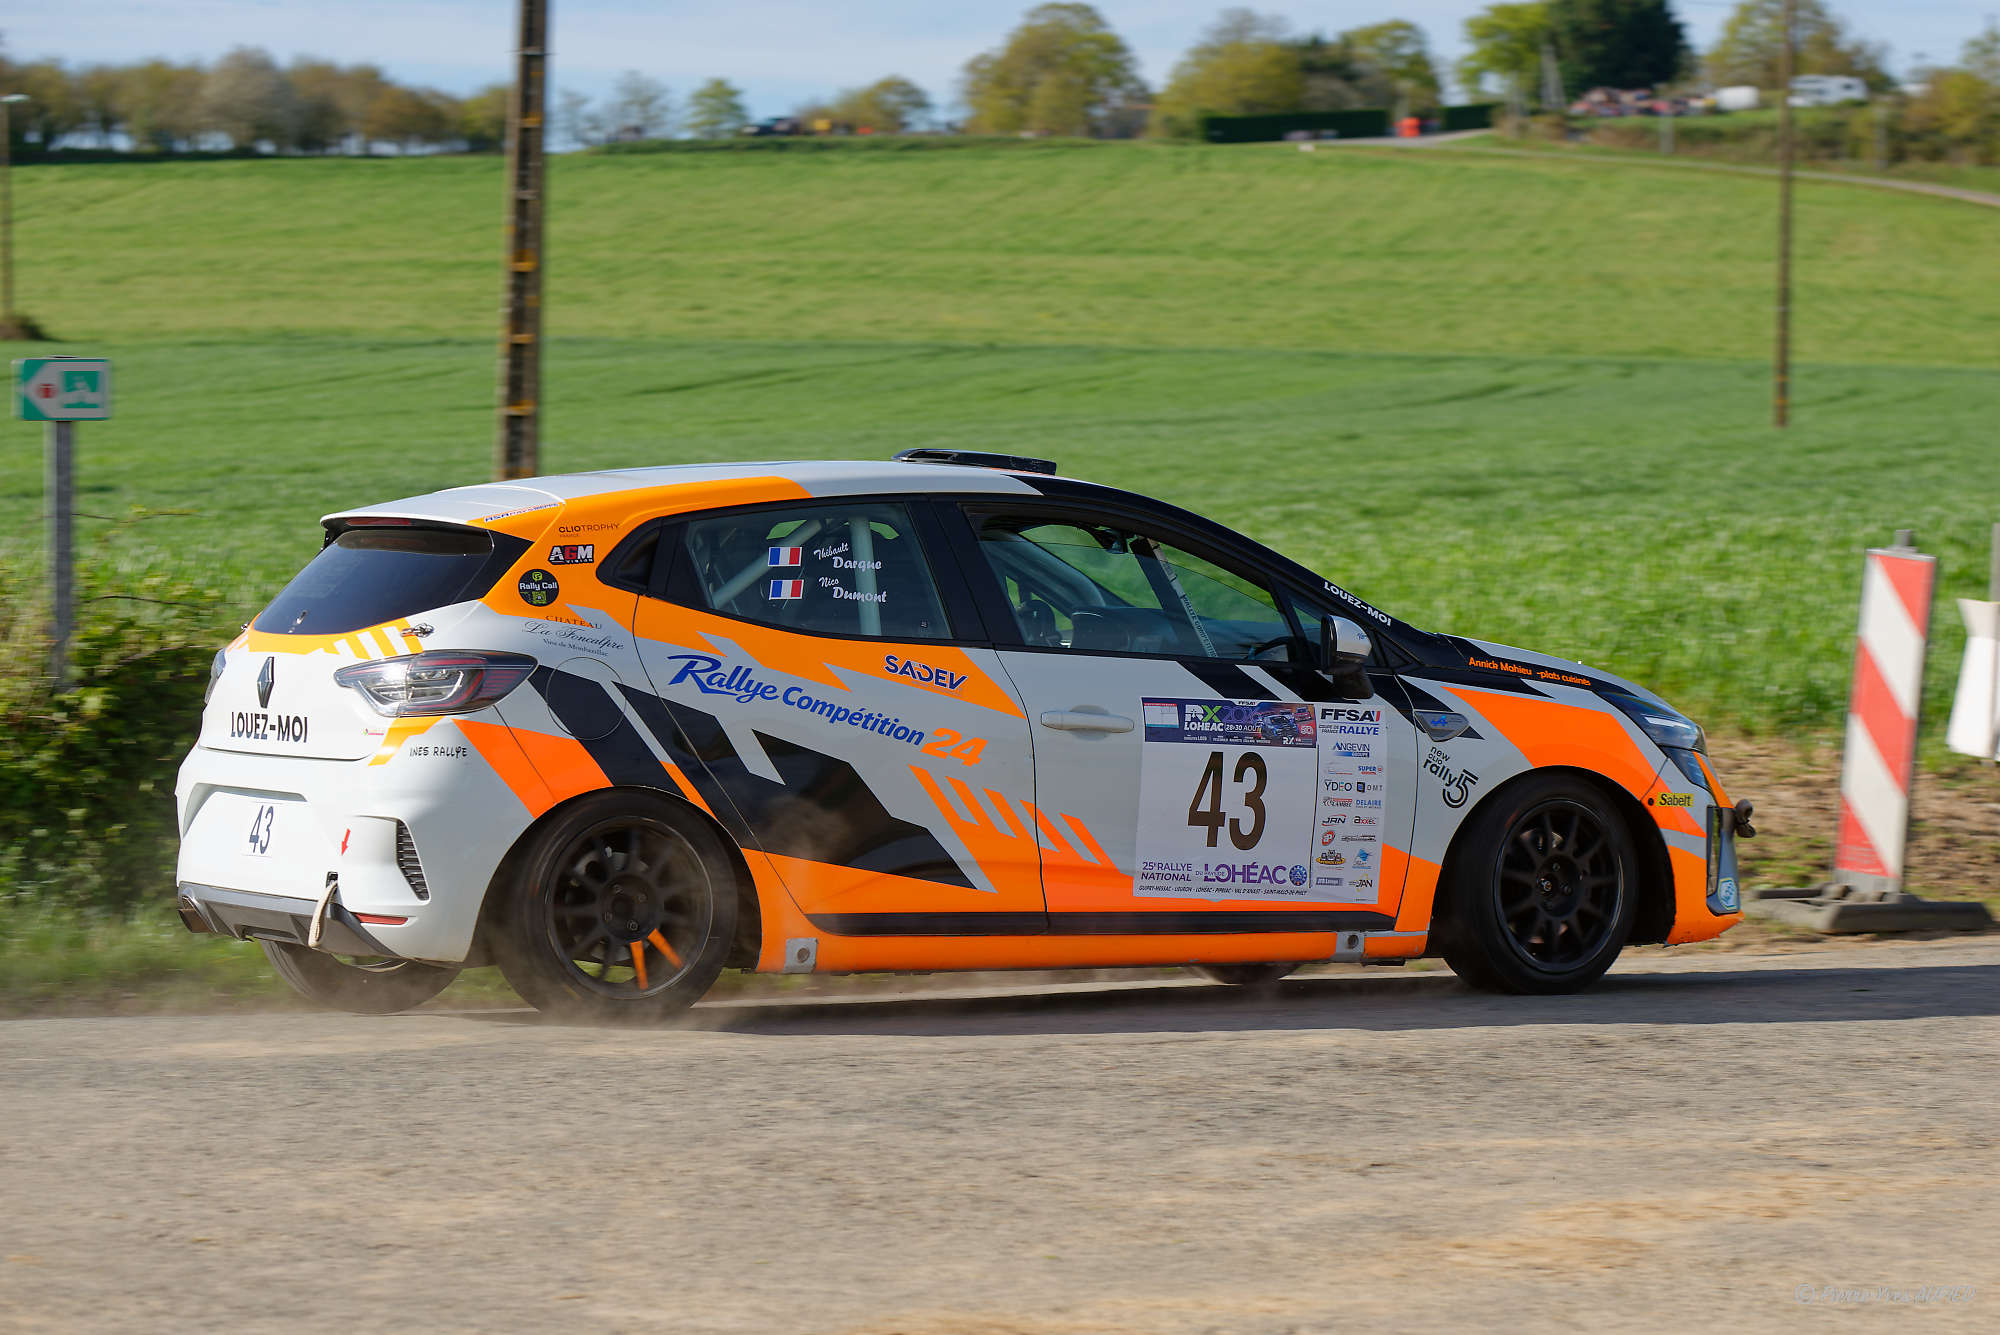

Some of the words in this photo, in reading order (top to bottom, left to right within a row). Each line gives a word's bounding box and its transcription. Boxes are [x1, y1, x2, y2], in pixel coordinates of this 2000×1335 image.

[519, 582, 541, 591] Rally
[818, 576, 839, 588] Nico
[832, 586, 887, 602] Dumont
[1323, 581, 1392, 627] LOUEZ-MOI
[884, 654, 969, 690] SADEV
[667, 653, 780, 704] Rallye
[782, 685, 926, 747] Compétition
[920, 727, 989, 768] 24
[1184, 704, 1222, 723] RX
[1320, 708, 1375, 722] FFSA
[230, 710, 309, 744] LOUEZ-MOI
[1183, 721, 1225, 732] LOHEAC
[1339, 725, 1380, 736] RALLYE
[409, 746, 429, 757] INES
[433, 745, 469, 758] RALLYE
[1332, 741, 1370, 752] ANGEVIN
[1428, 753, 1443, 765] CLIO
[1431, 746, 1450, 762] new
[1187, 751, 1268, 851] 43
[1659, 793, 1691, 807] Sabelt
[248, 804, 275, 855] 43
[1157, 862, 1193, 872] RALLYE
[1203, 861, 1287, 885] LOHÉAC
[1140, 872, 1192, 882] NATIONAL
